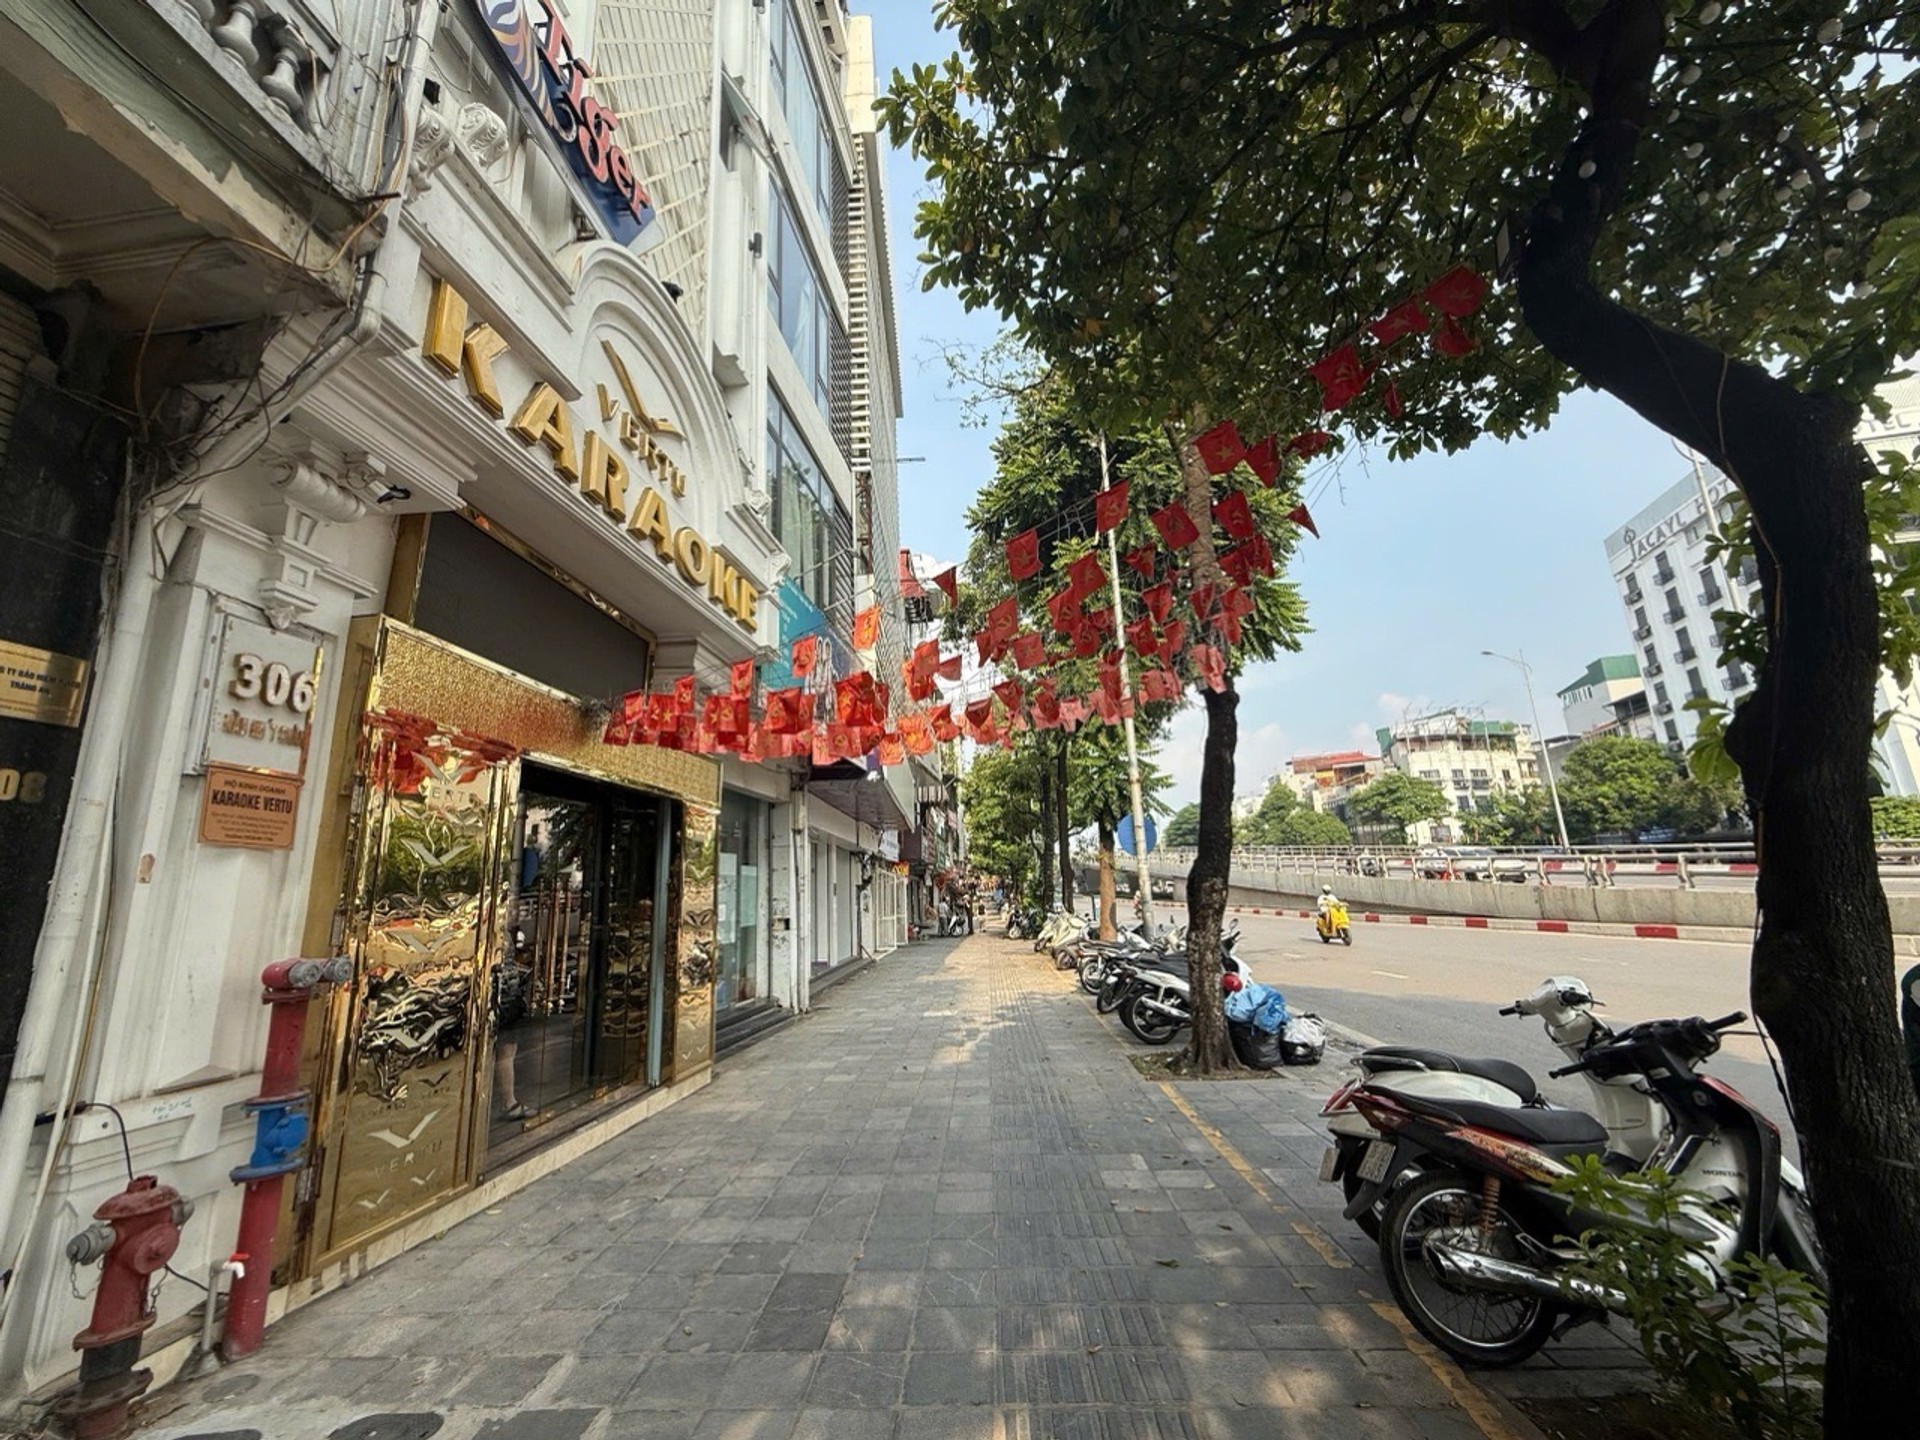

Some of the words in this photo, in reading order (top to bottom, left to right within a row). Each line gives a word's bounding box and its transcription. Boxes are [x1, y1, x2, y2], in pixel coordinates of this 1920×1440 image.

[422, 277, 760, 633] KARAOKE
[597, 383, 686, 498] VERTU
[228, 653, 316, 714] 306
[211, 789, 261, 810] KARAOKE
[263, 796, 293, 815] VERTU
